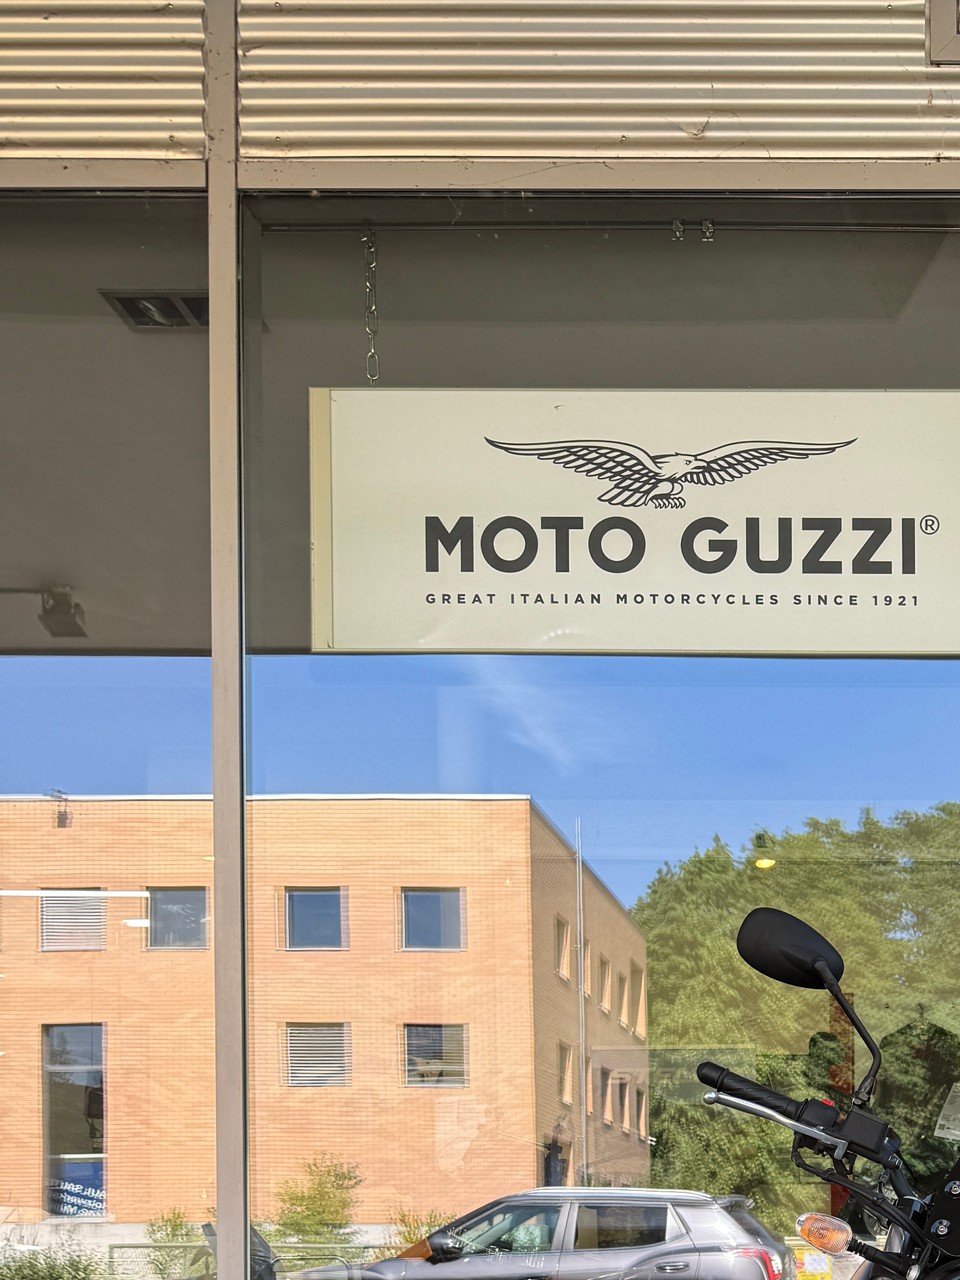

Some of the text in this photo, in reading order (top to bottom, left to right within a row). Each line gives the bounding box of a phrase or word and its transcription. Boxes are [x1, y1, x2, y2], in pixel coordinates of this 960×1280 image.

[425, 516, 646, 573] MOTO
[426, 593, 919, 607] GREAT ITALIAN MOTORCYCLES SINCE 1921
